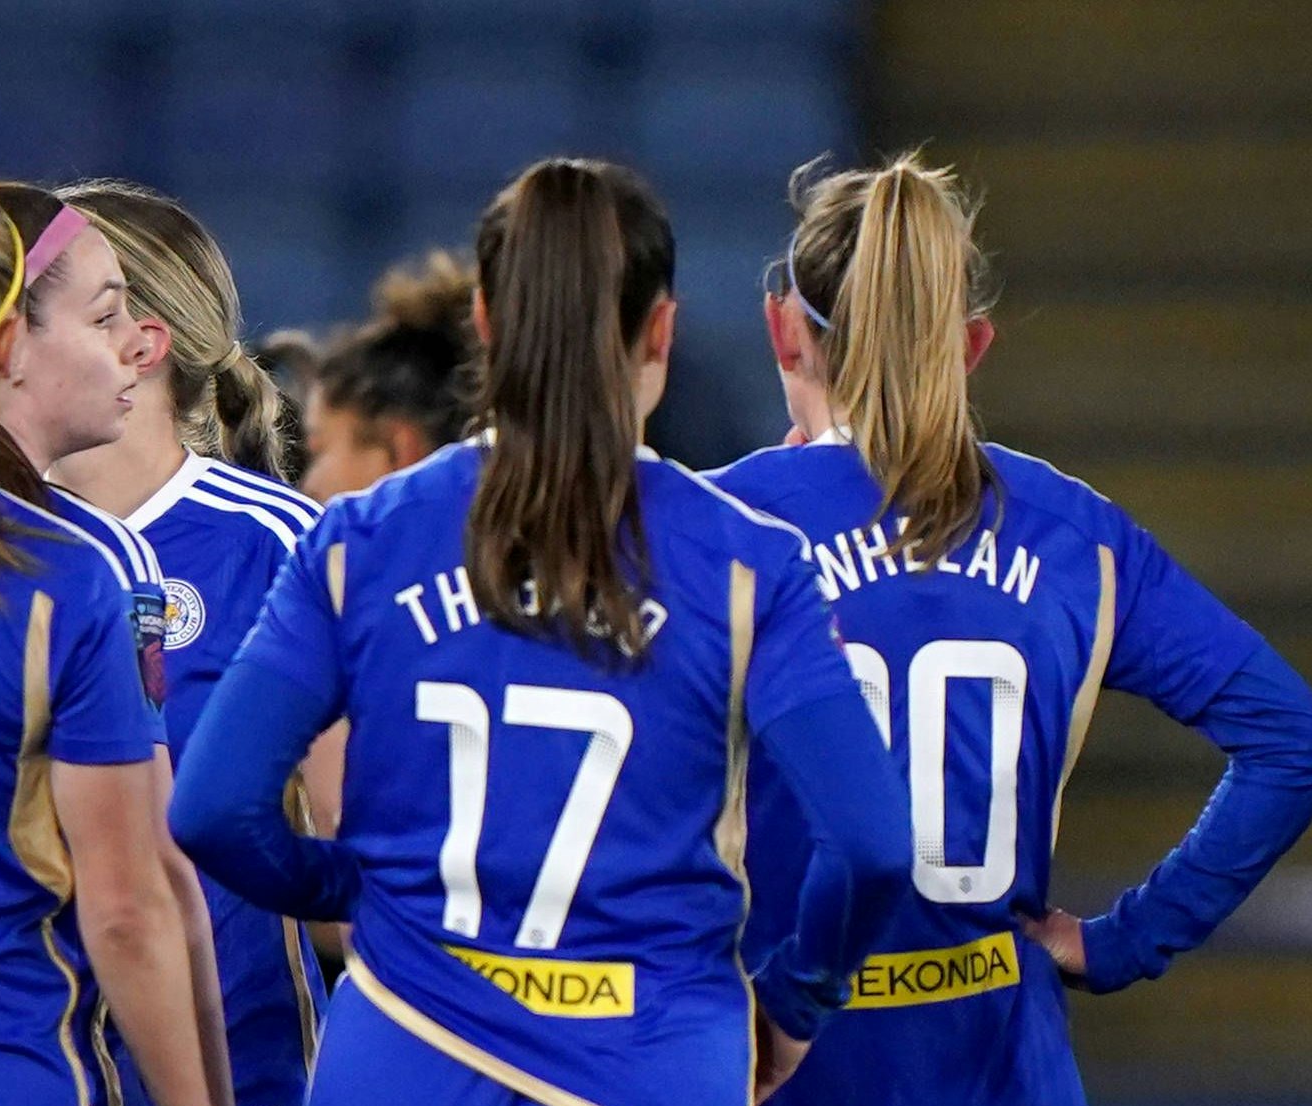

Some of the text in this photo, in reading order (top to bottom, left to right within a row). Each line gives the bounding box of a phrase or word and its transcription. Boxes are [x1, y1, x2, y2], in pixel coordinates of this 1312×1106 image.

[415, 681, 634, 950] 17
[845, 640, 1029, 904] 0
[465, 958, 622, 1007] ONDA
[857, 946, 1011, 998] EKONDA
